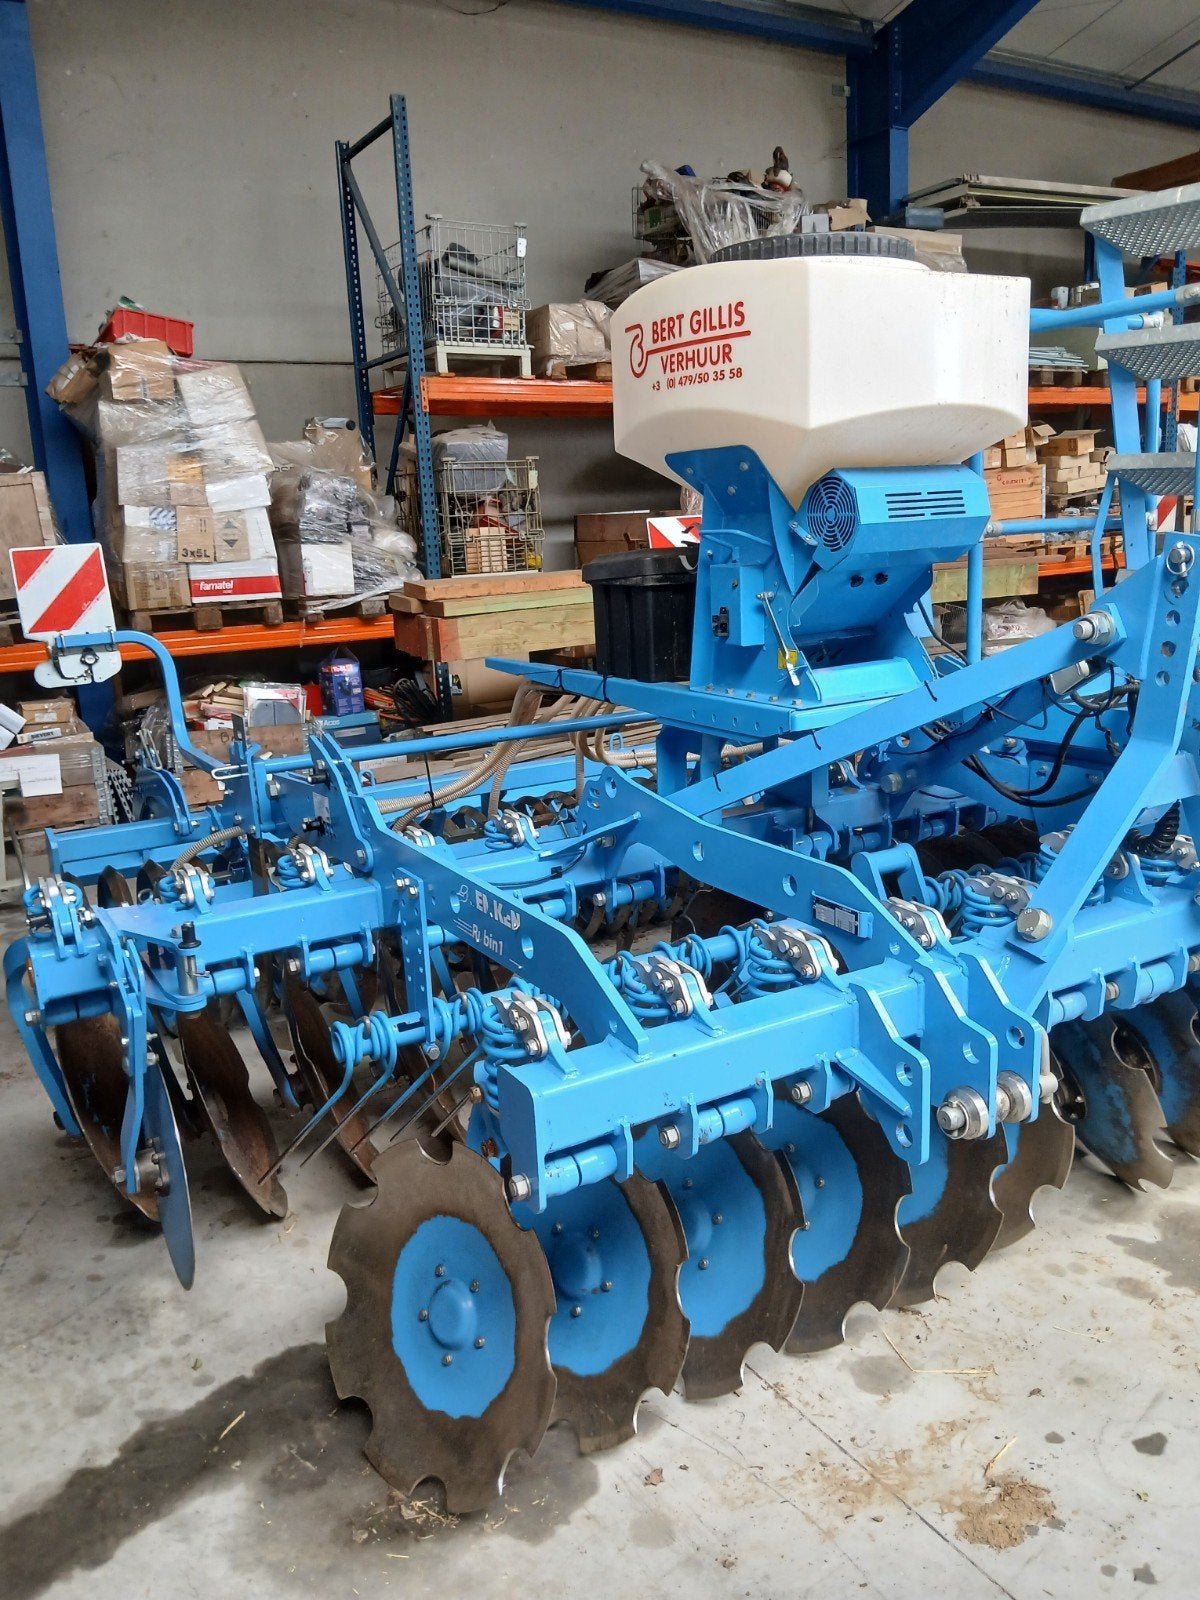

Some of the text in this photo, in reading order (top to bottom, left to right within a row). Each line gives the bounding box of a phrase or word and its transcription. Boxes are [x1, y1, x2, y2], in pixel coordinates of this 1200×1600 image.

[652, 301, 745, 344] BERT GILLIS
[660, 343, 732, 374] VERHUUR
[666, 376, 676, 390] (0)
[678, 372, 709, 387] 479/50
[712, 369, 725, 381] 35
[729, 367, 743, 379] 58
[181, 547, 210, 558] 3x5L
[199, 580, 234, 591] famatel
